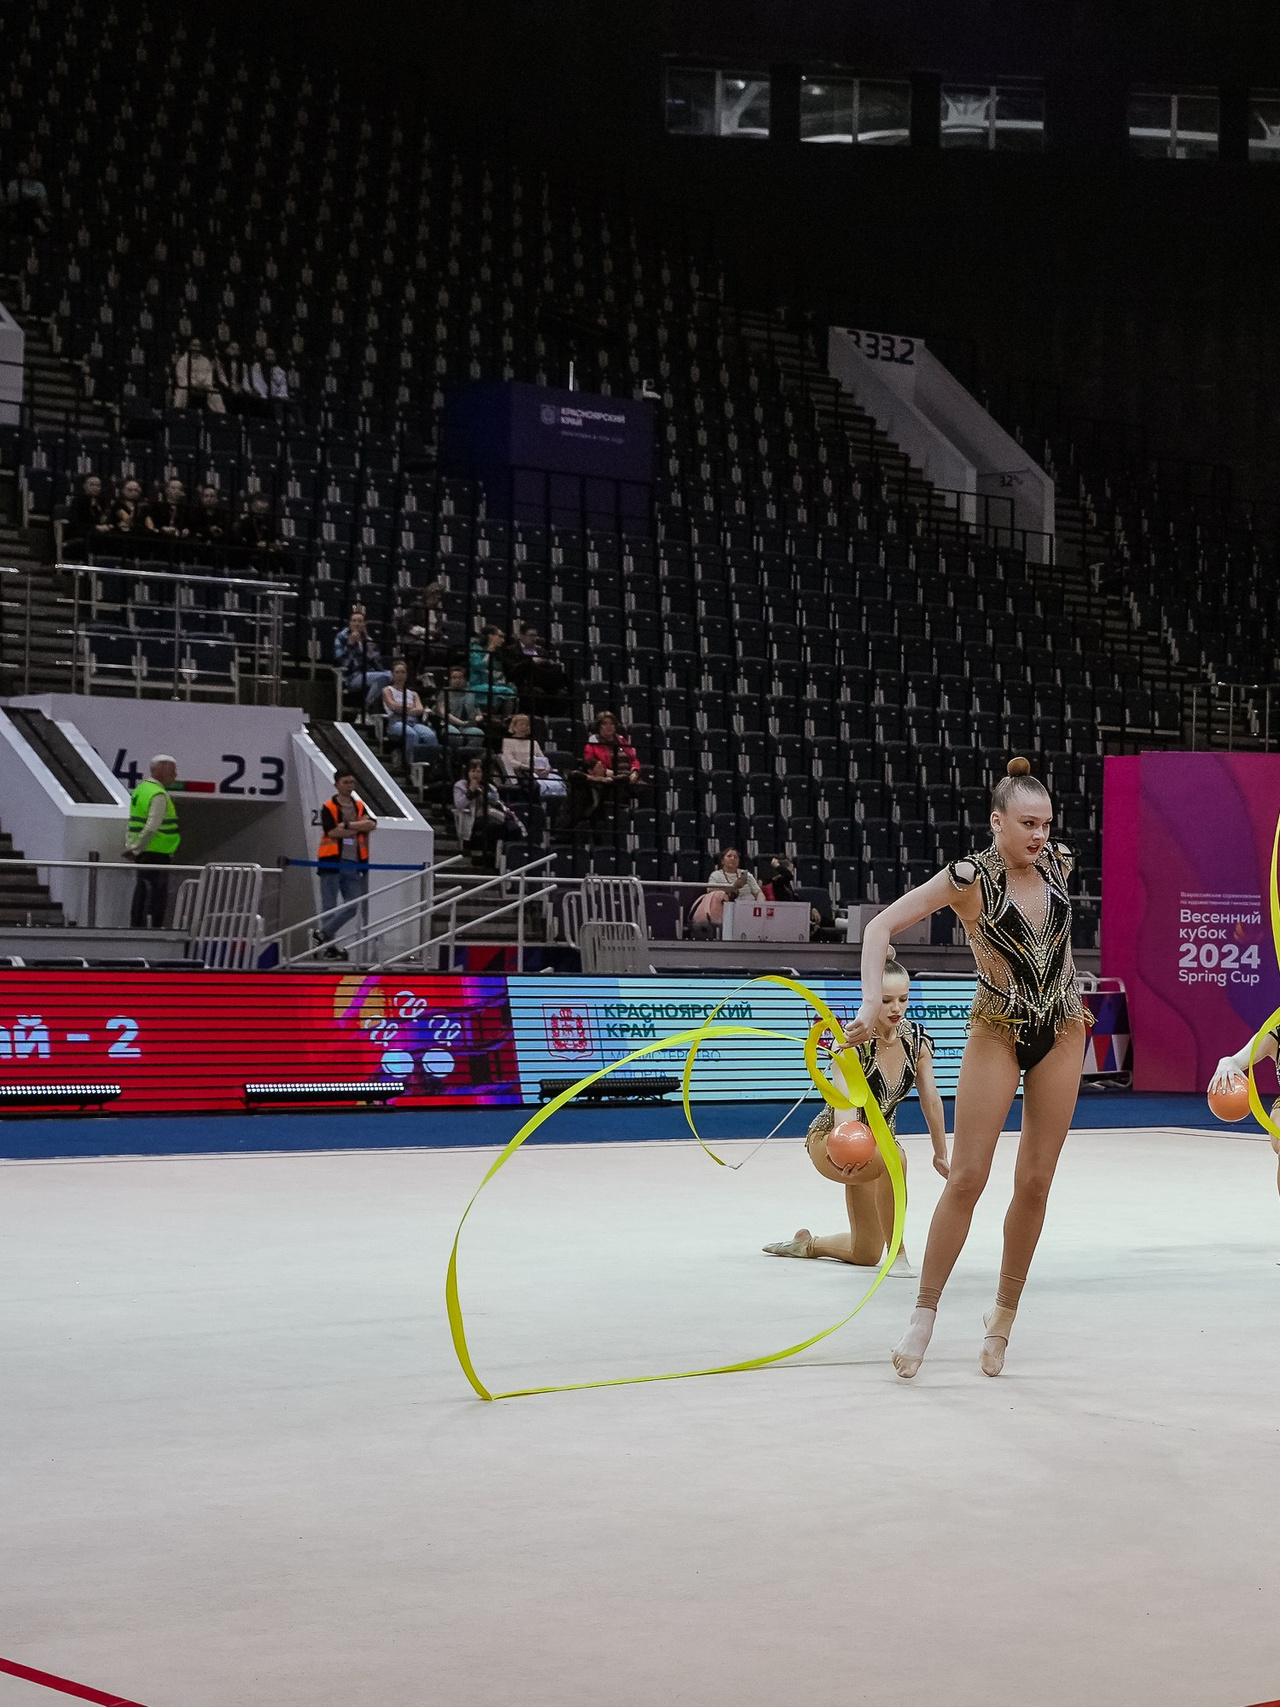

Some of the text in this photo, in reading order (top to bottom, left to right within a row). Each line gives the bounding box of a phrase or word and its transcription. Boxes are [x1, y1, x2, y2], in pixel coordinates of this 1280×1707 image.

[219, 754, 285, 796] 2.3
[1180, 909, 1262, 925] Весенний
[1179, 925, 1227, 942] кубок
[1179, 942, 1261, 969] 2024
[1179, 969, 1260, 987] Spring Cup
[604, 1001, 753, 1019] КРАСНОЯРСКИЙ
[106, 1015, 142, 1058] 2
[606, 1019, 657, 1038] КРАЙ
